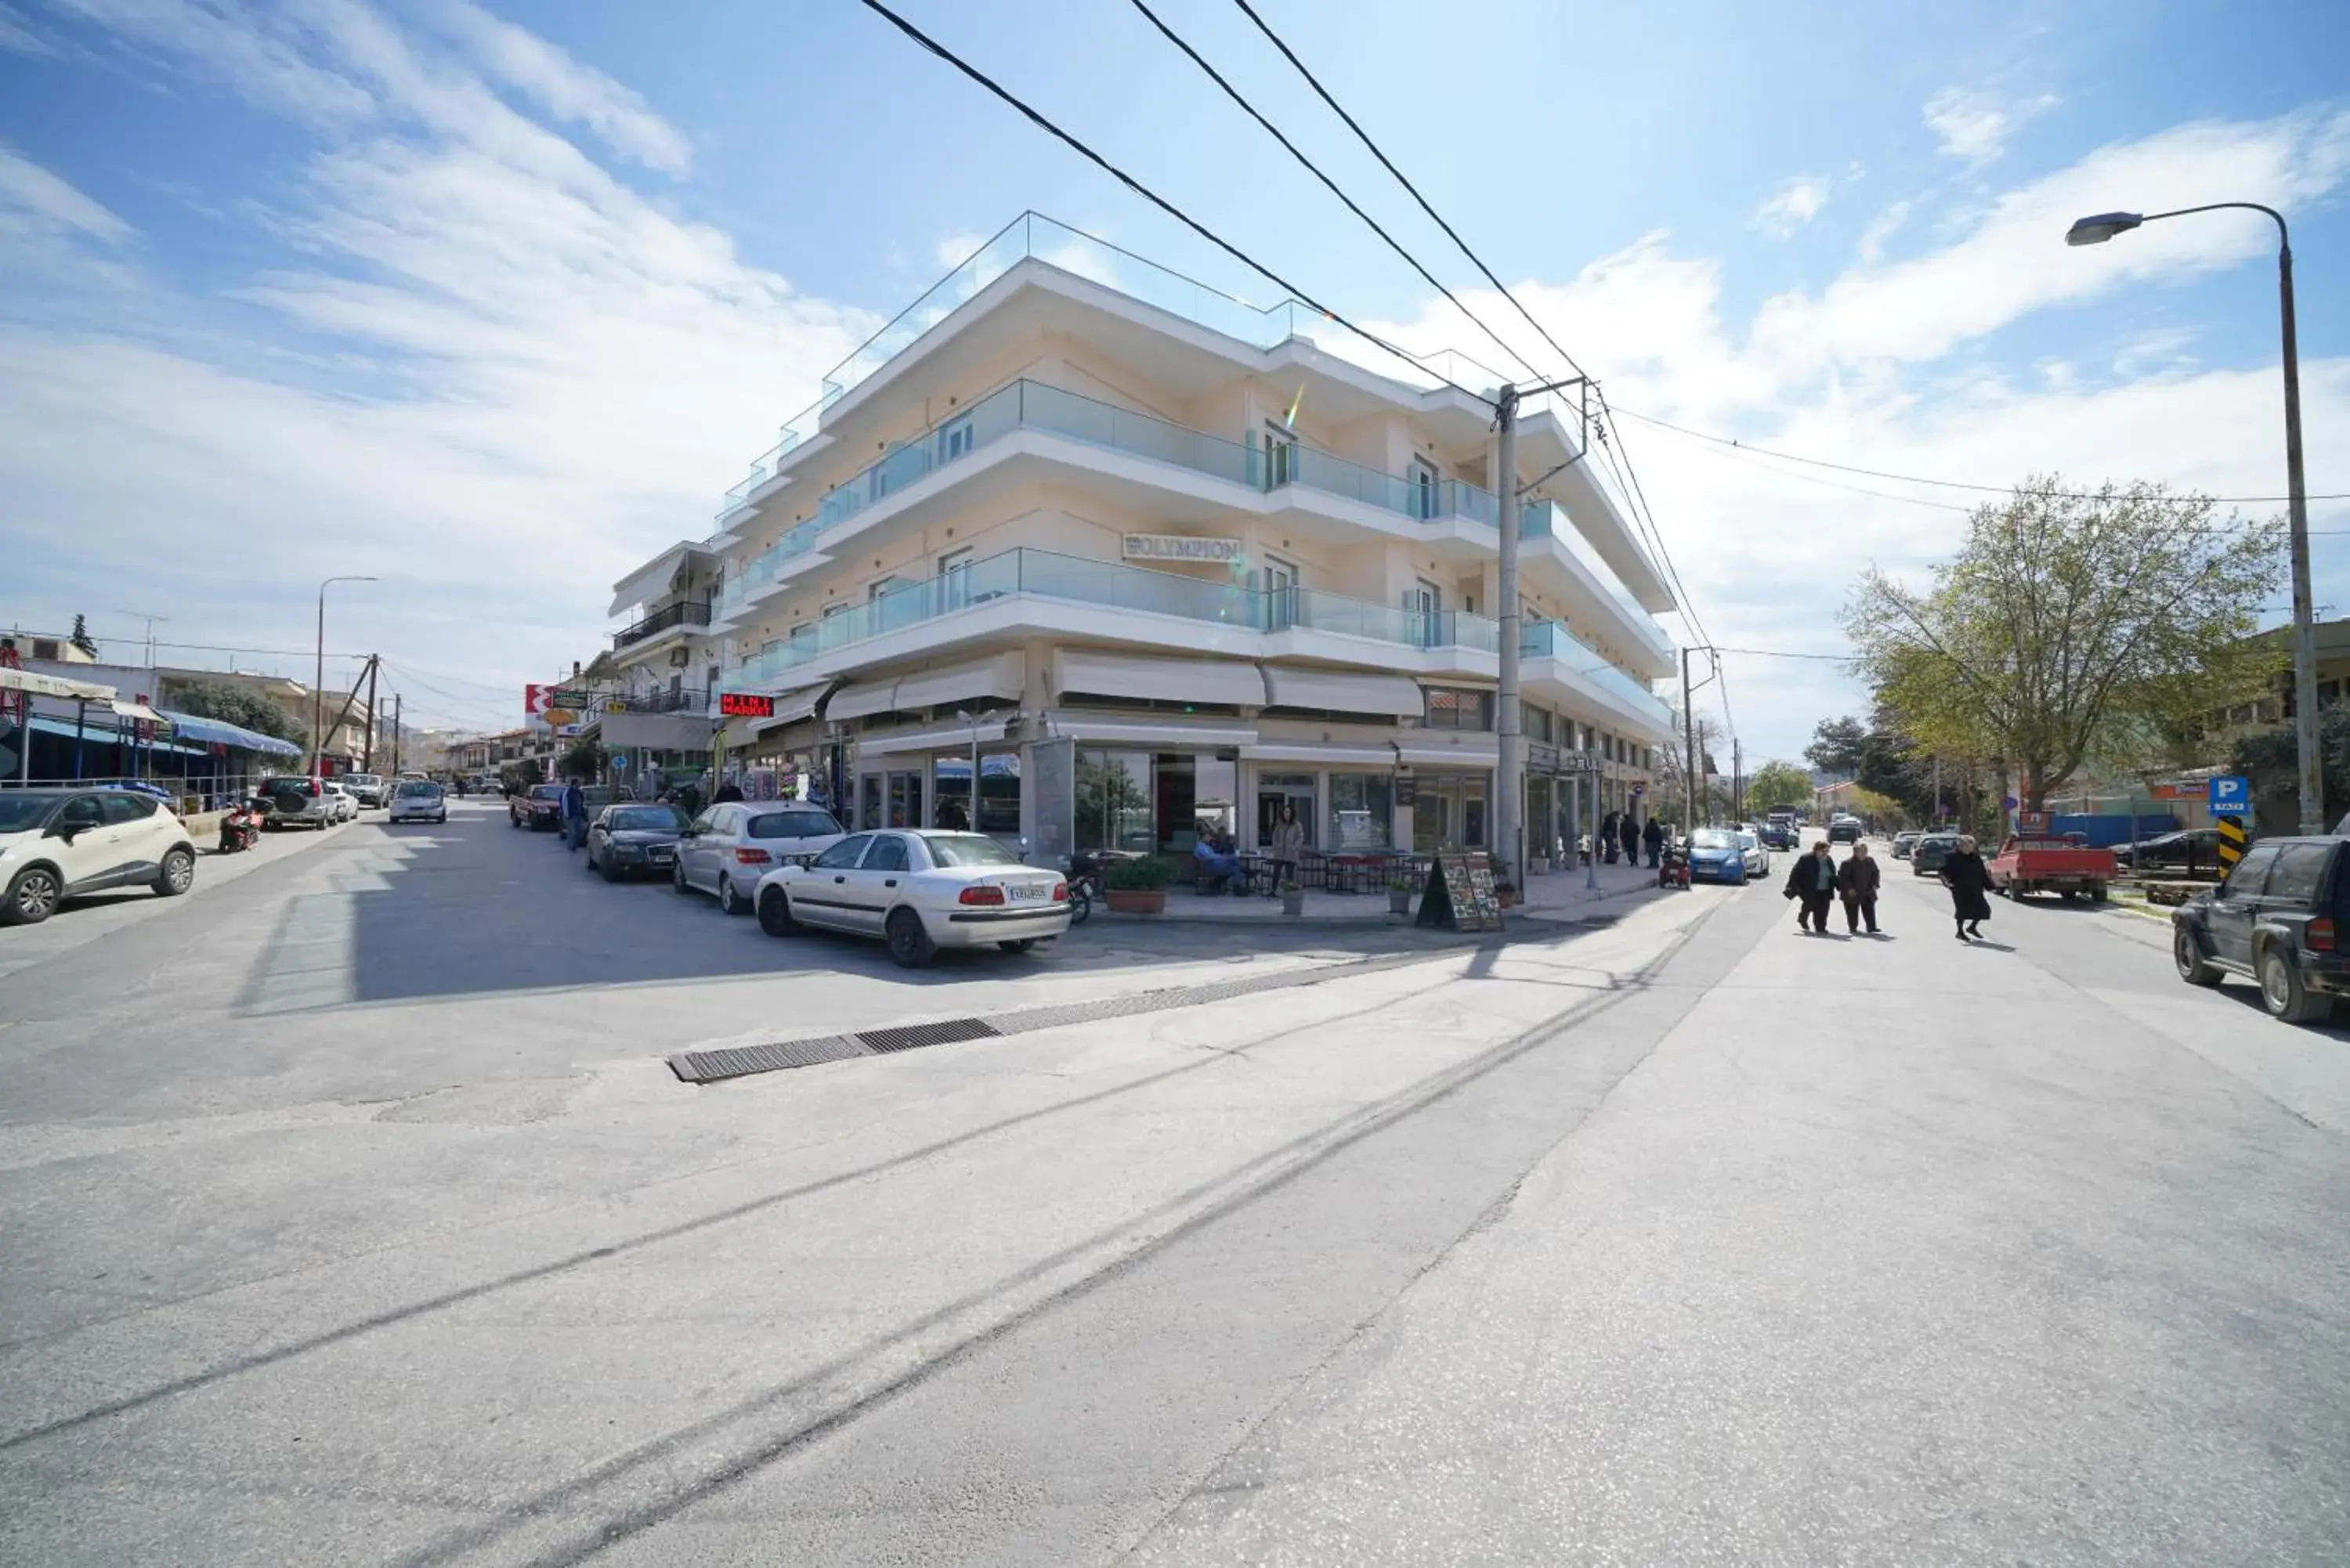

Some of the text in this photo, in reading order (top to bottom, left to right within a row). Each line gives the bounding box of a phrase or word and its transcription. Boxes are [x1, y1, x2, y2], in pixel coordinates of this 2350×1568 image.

[1140, 537, 1238, 560] OLYMPION
[723, 704, 771, 717] MARKET
[2218, 781, 2238, 797] P
